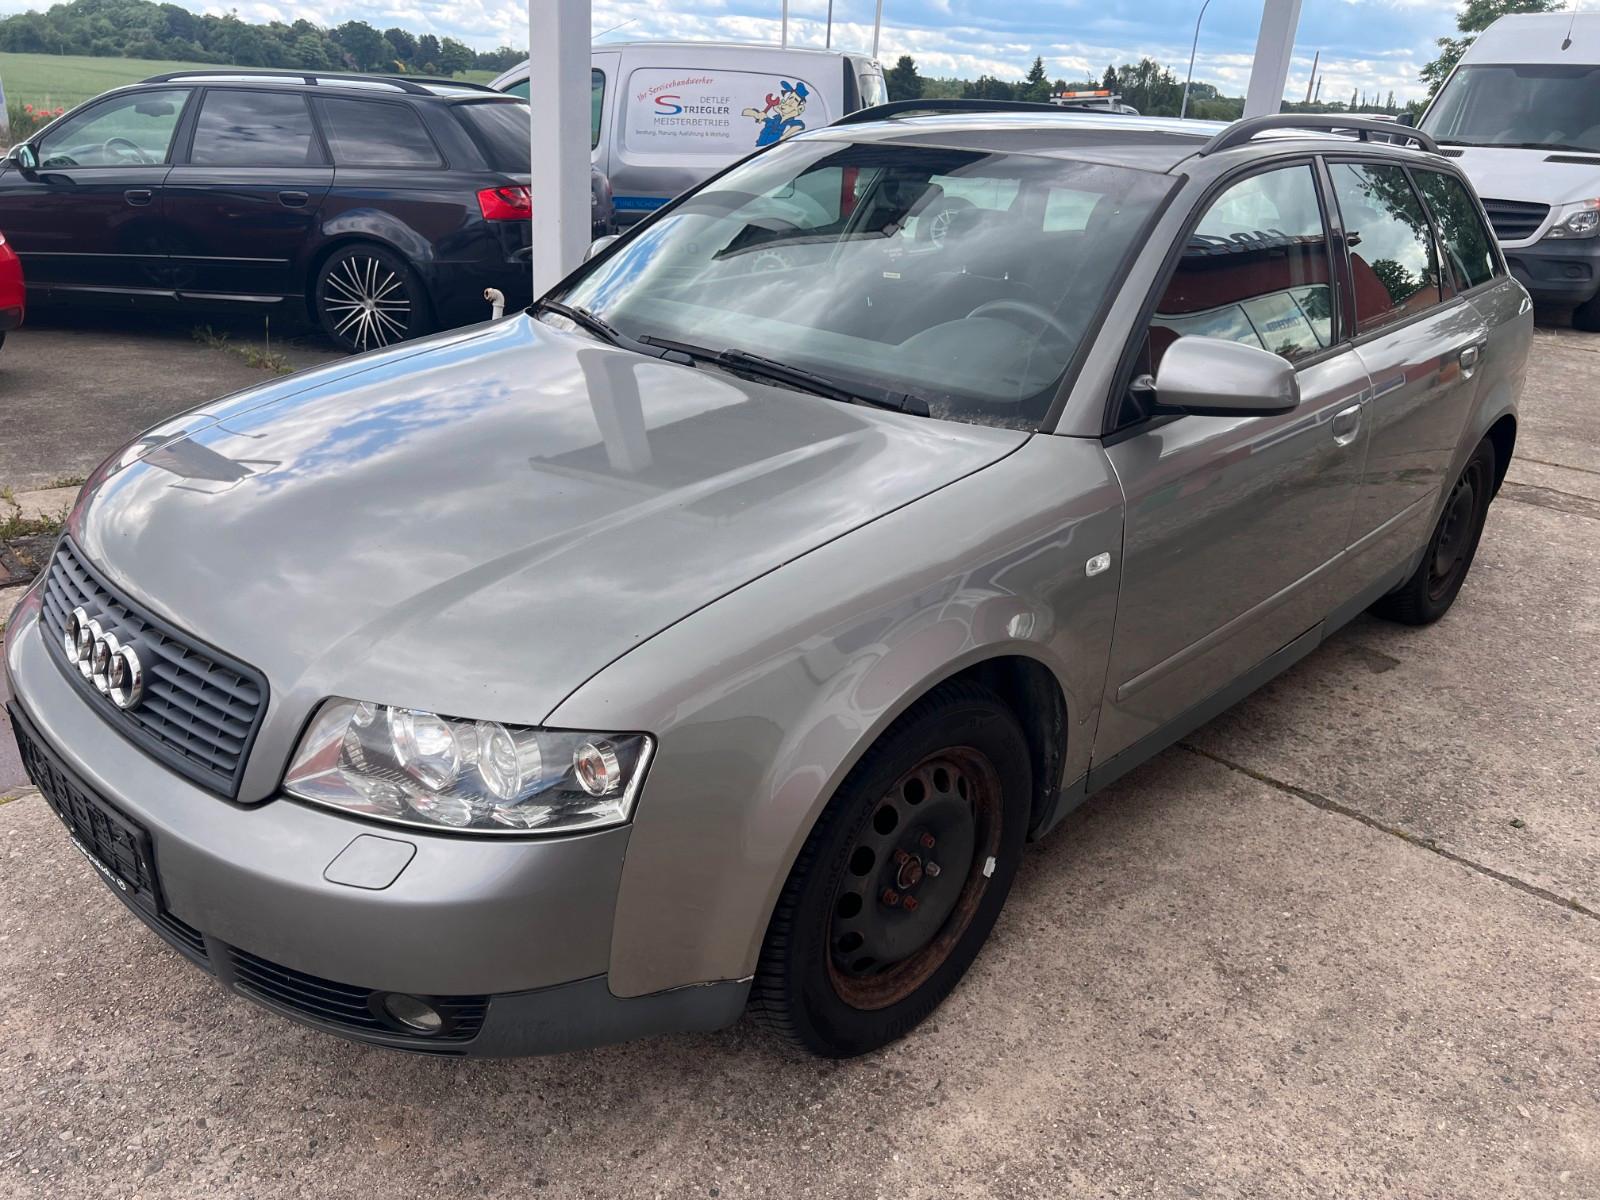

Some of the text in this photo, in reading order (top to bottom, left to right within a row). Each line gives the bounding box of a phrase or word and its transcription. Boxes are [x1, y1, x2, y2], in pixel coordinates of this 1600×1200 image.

[648, 76, 714, 96] Servicehandwerker
[654, 94, 730, 115] STRIEGLER
[699, 96, 730, 104] DETLEF
[654, 117, 730, 127] MEISTERBETRIEB
